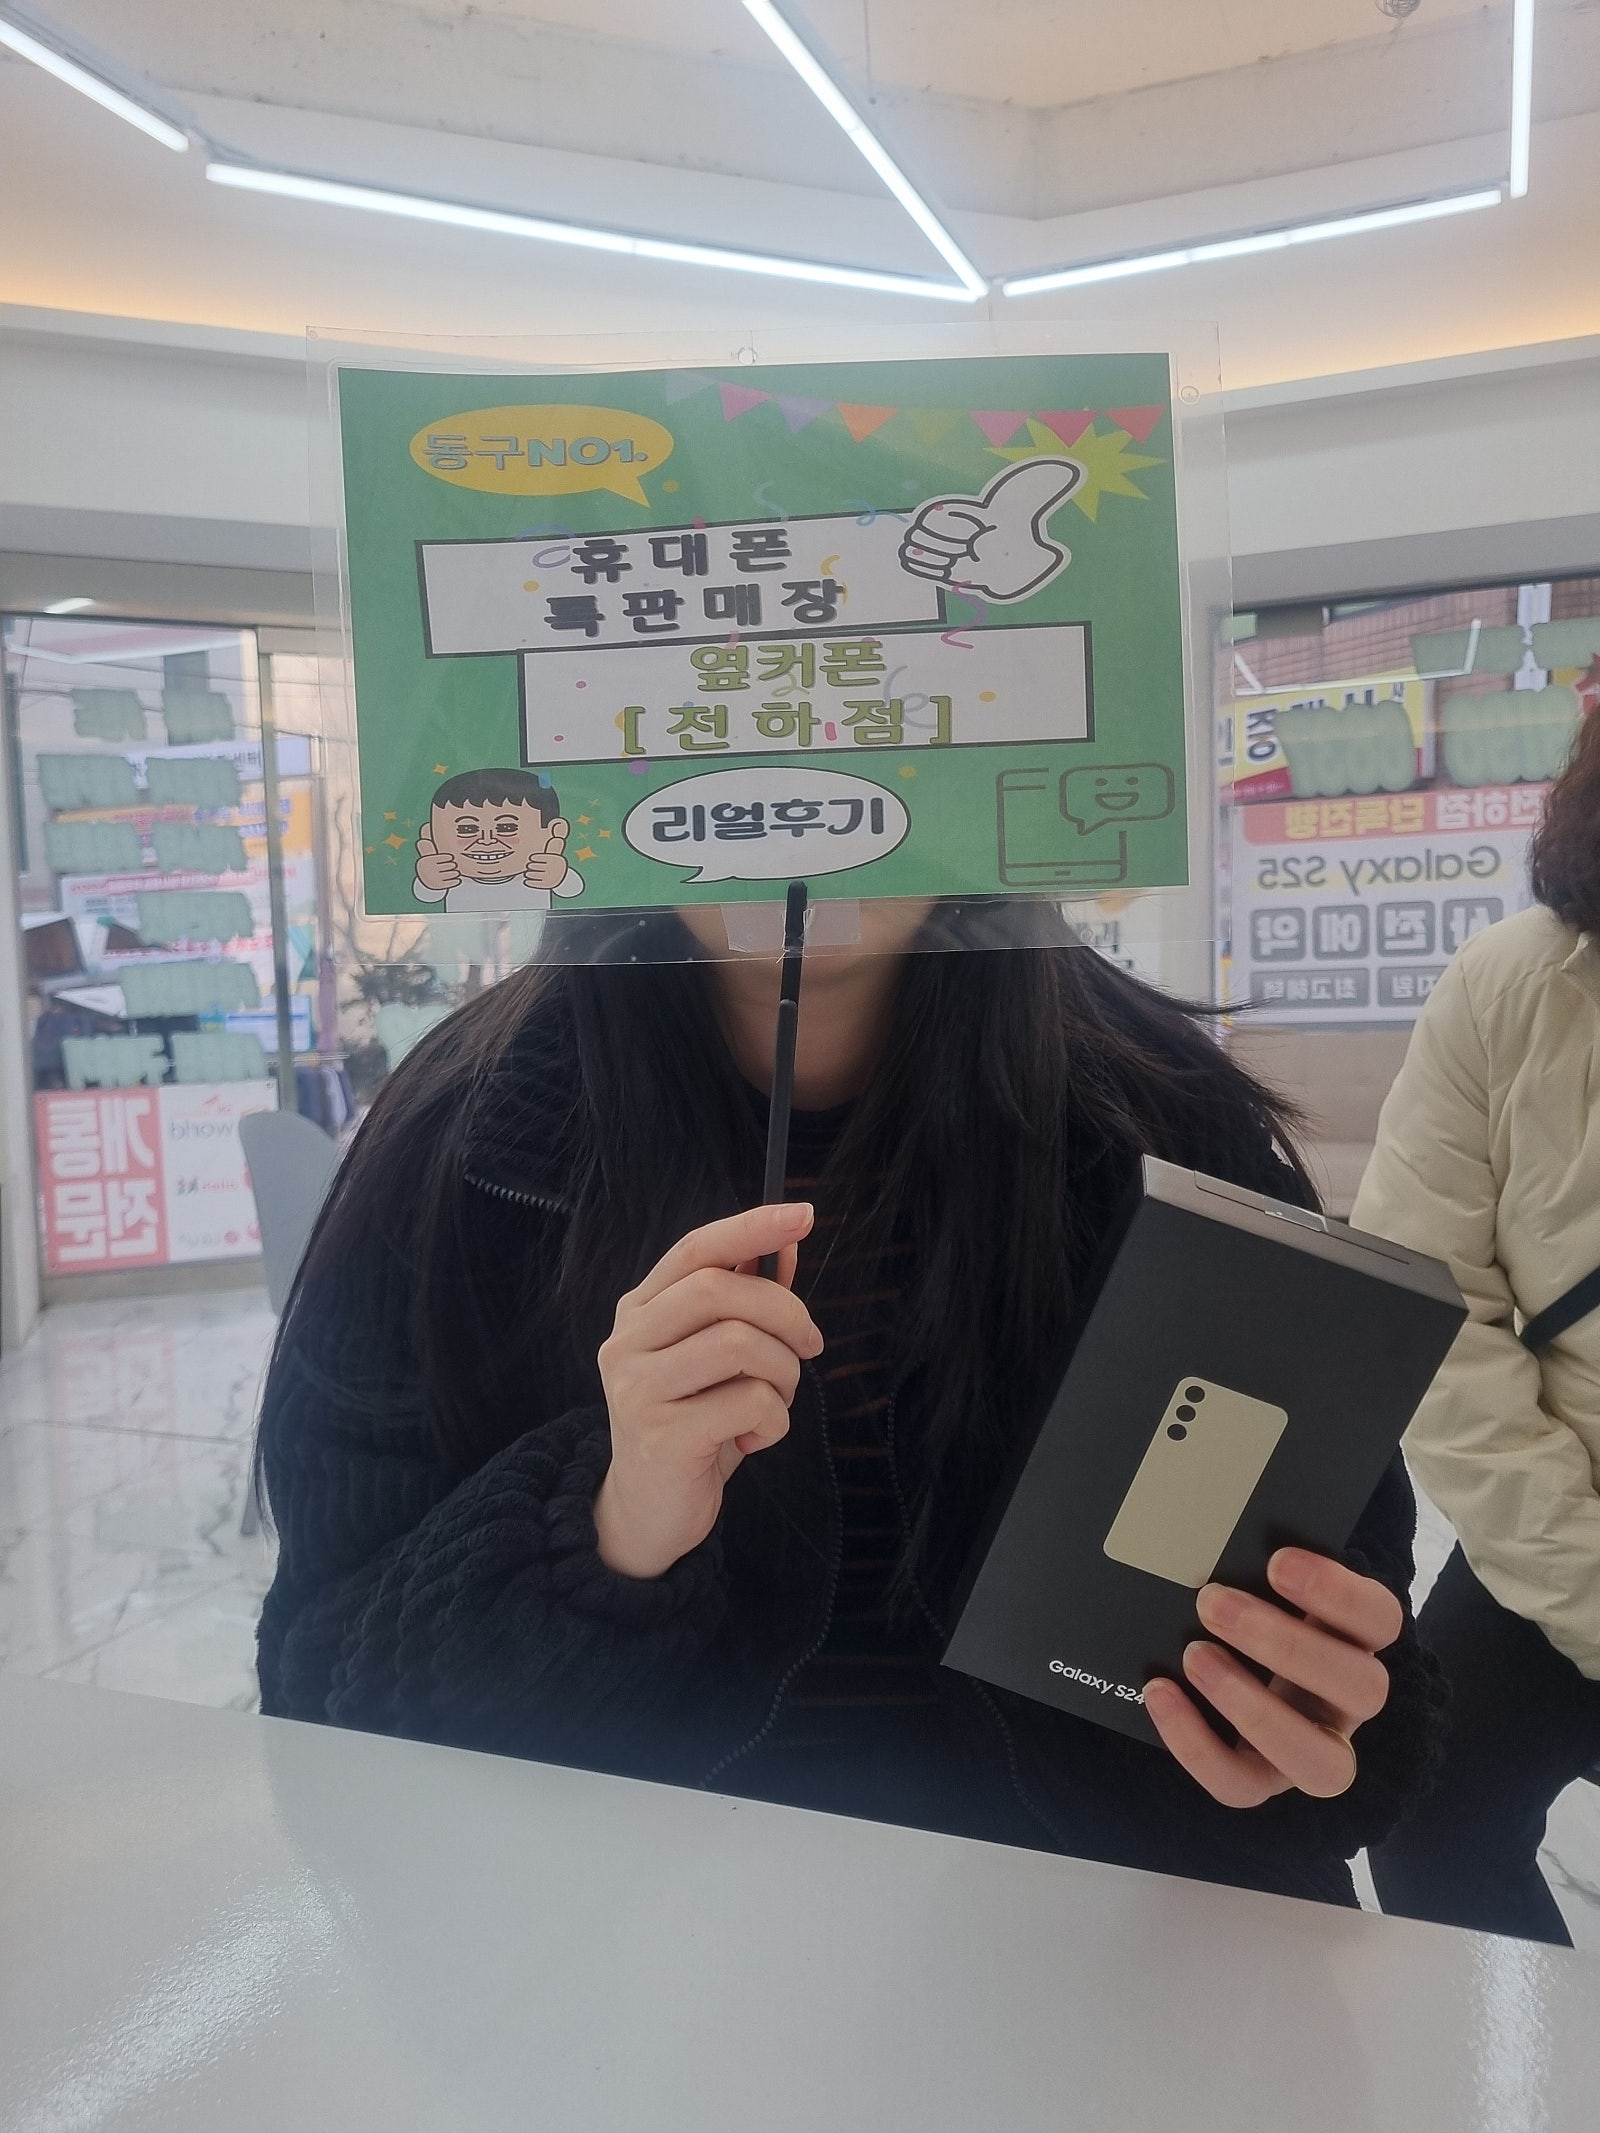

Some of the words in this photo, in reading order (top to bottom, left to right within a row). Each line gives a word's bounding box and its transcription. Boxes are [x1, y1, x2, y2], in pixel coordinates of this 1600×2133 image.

[424, 434, 649, 470] 동구NO1.
[571, 528, 793, 584] 휴대폰
[544, 578, 846, 637] 특판매장
[690, 641, 886, 692] 옆커폰
[652, 798, 885, 842] 리얼후기
[1049, 1660, 1114, 1694] Galaxy
[1114, 1685, 1145, 1705] S24
